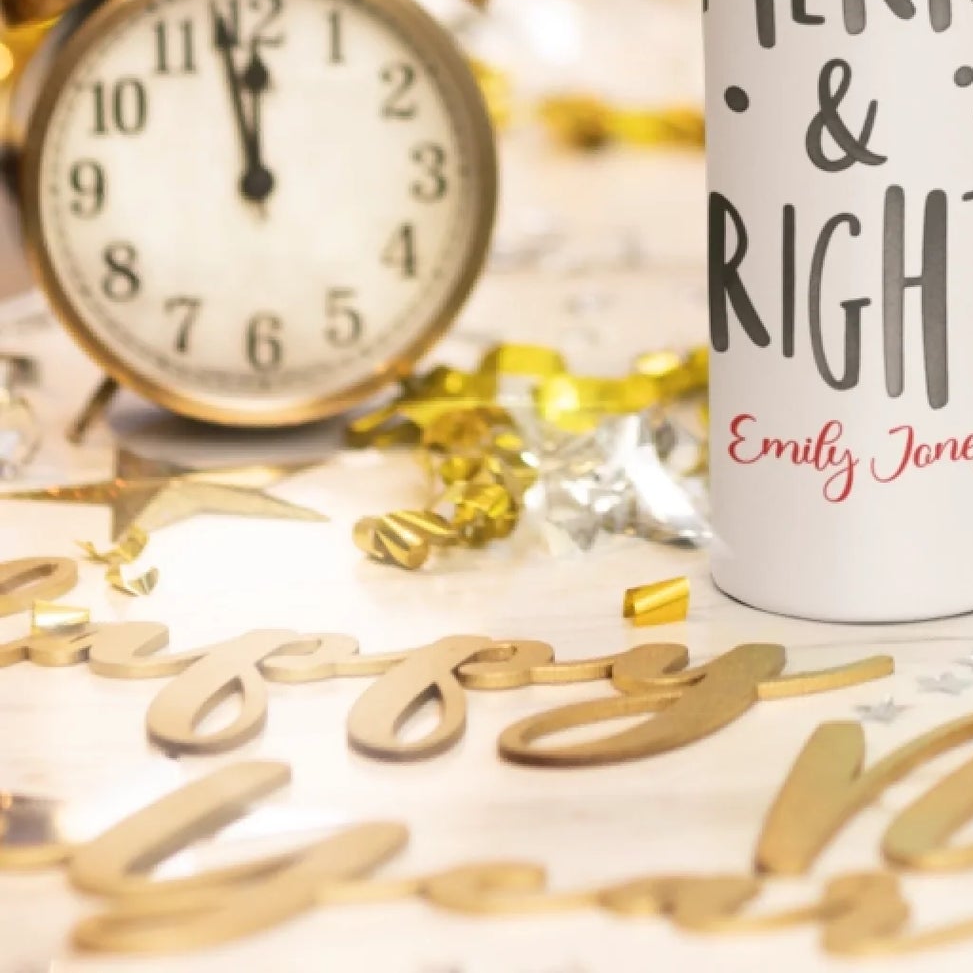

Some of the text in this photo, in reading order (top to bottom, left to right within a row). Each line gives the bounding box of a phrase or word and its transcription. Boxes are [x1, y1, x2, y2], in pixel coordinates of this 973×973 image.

[154, 20, 197, 75] 11
[326, 10, 345, 64] 1
[90, 77, 147, 135] 10
[379, 62, 416, 120] 2
[805, 58, 888, 172] &
[69, 160, 107, 217] 9
[411, 142, 449, 203] 3
[101, 242, 141, 303] 8
[380, 222, 418, 279] 4
[164, 296, 201, 353] 7
[244, 311, 284, 372] 6
[325, 288, 363, 349] 5
[727, 413, 859, 503] Emily
